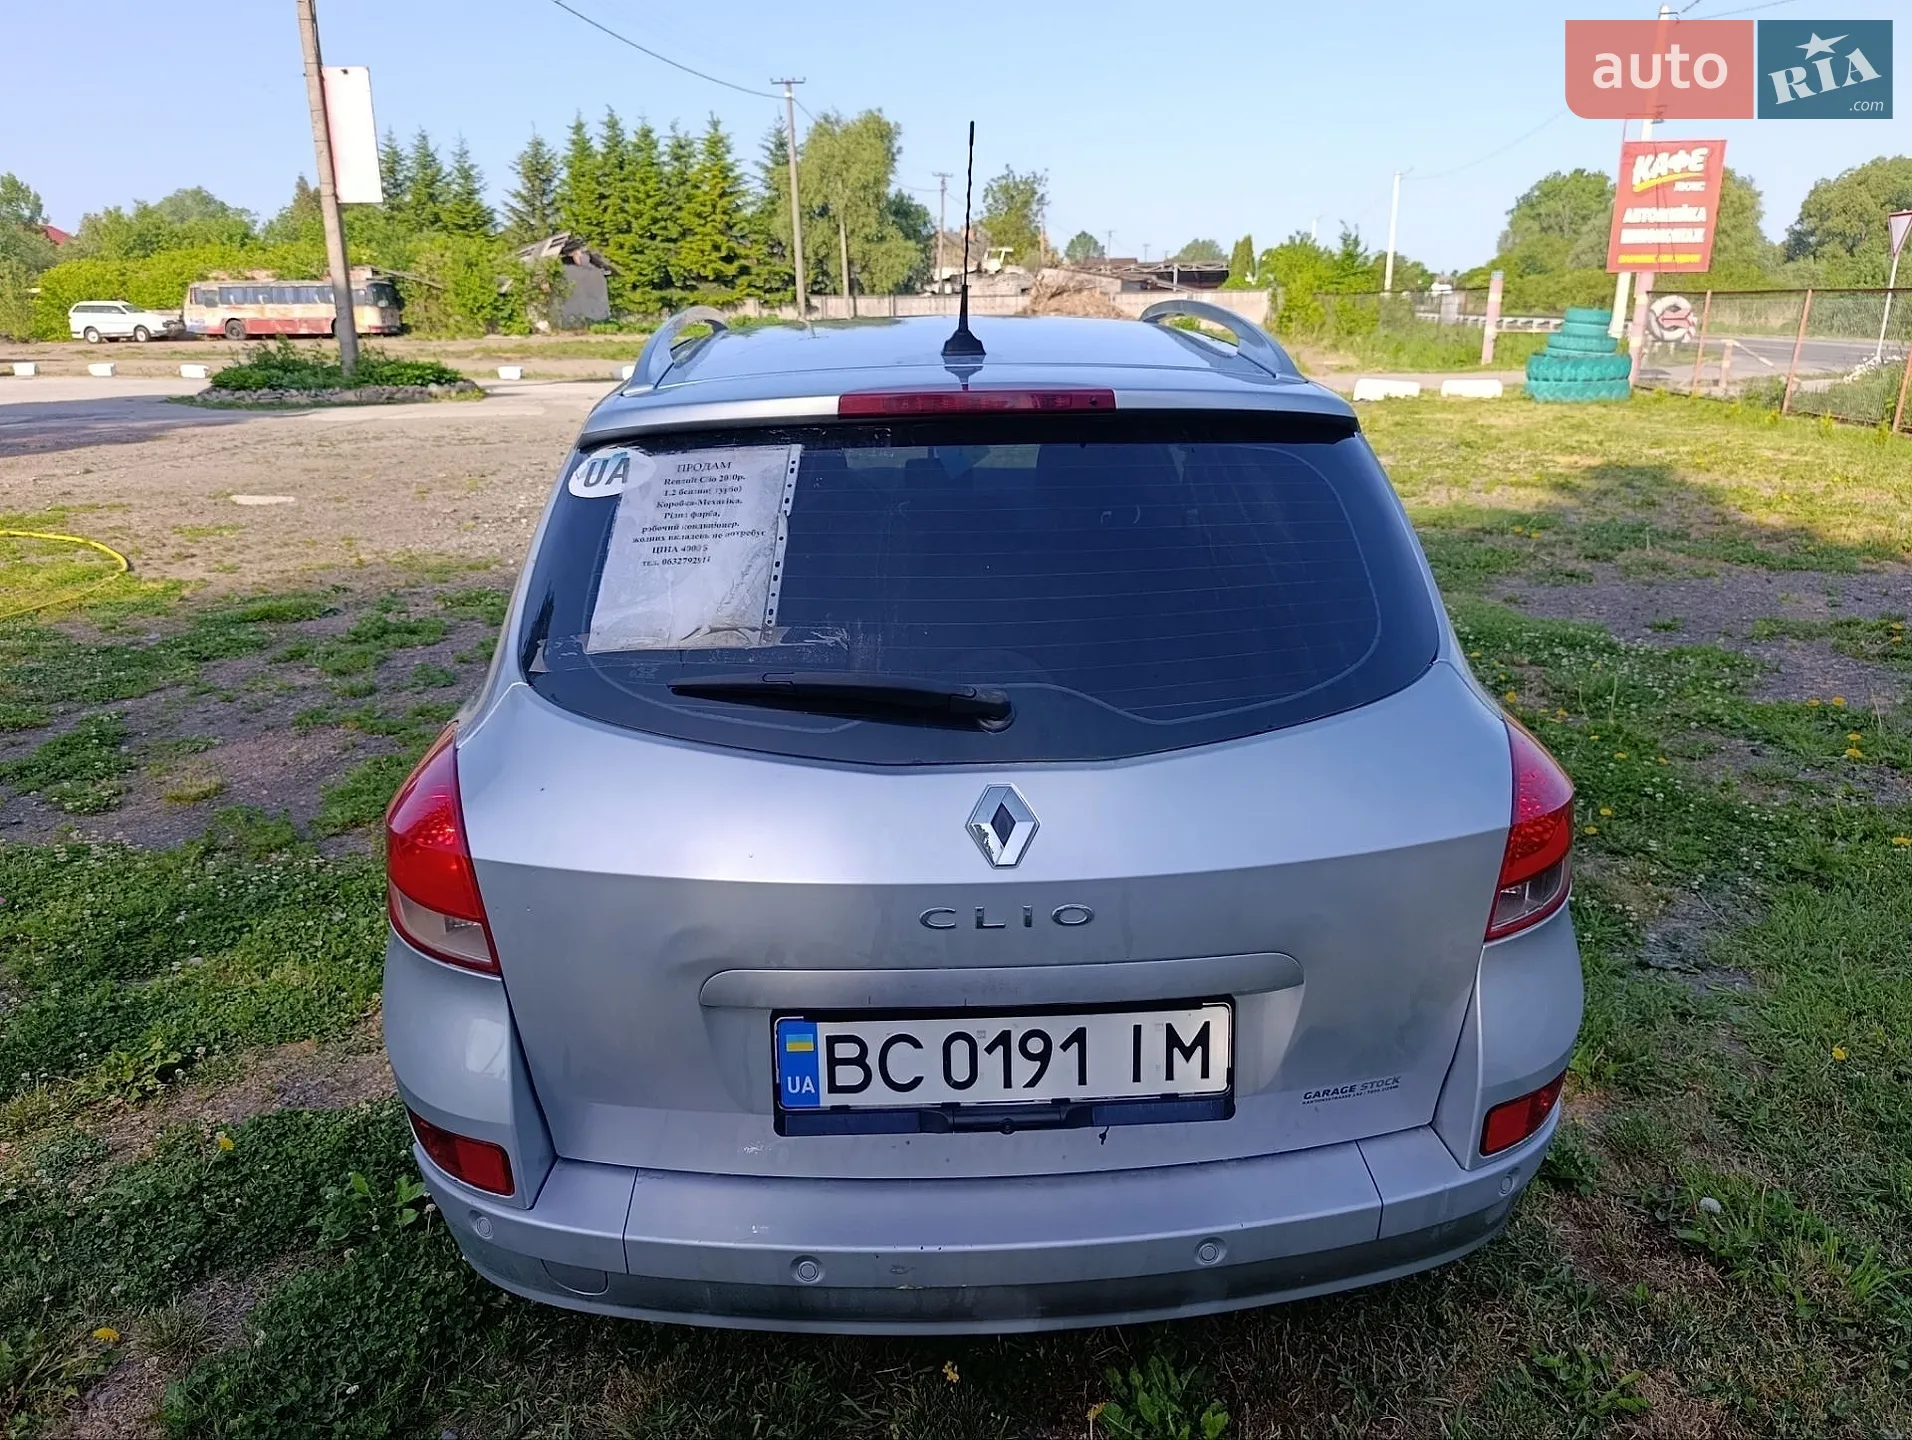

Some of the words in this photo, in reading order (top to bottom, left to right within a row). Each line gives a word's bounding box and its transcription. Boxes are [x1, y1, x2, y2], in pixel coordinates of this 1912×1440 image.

[1632, 147, 1709, 186] КАФЕ
[584, 456, 630, 488] UA
[677, 461, 732, 473] ПРОДАМ
[664, 489, 676, 497] 1.2
[919, 903, 1096, 930] CLIO
[825, 1033, 925, 1095] BC
[942, 1026, 1089, 1091] 0191
[1132, 1020, 1211, 1084] IM
[787, 1076, 816, 1094] UA
[1303, 1084, 1357, 1100] GARAGE
[1360, 1075, 1401, 1091] STOCK
